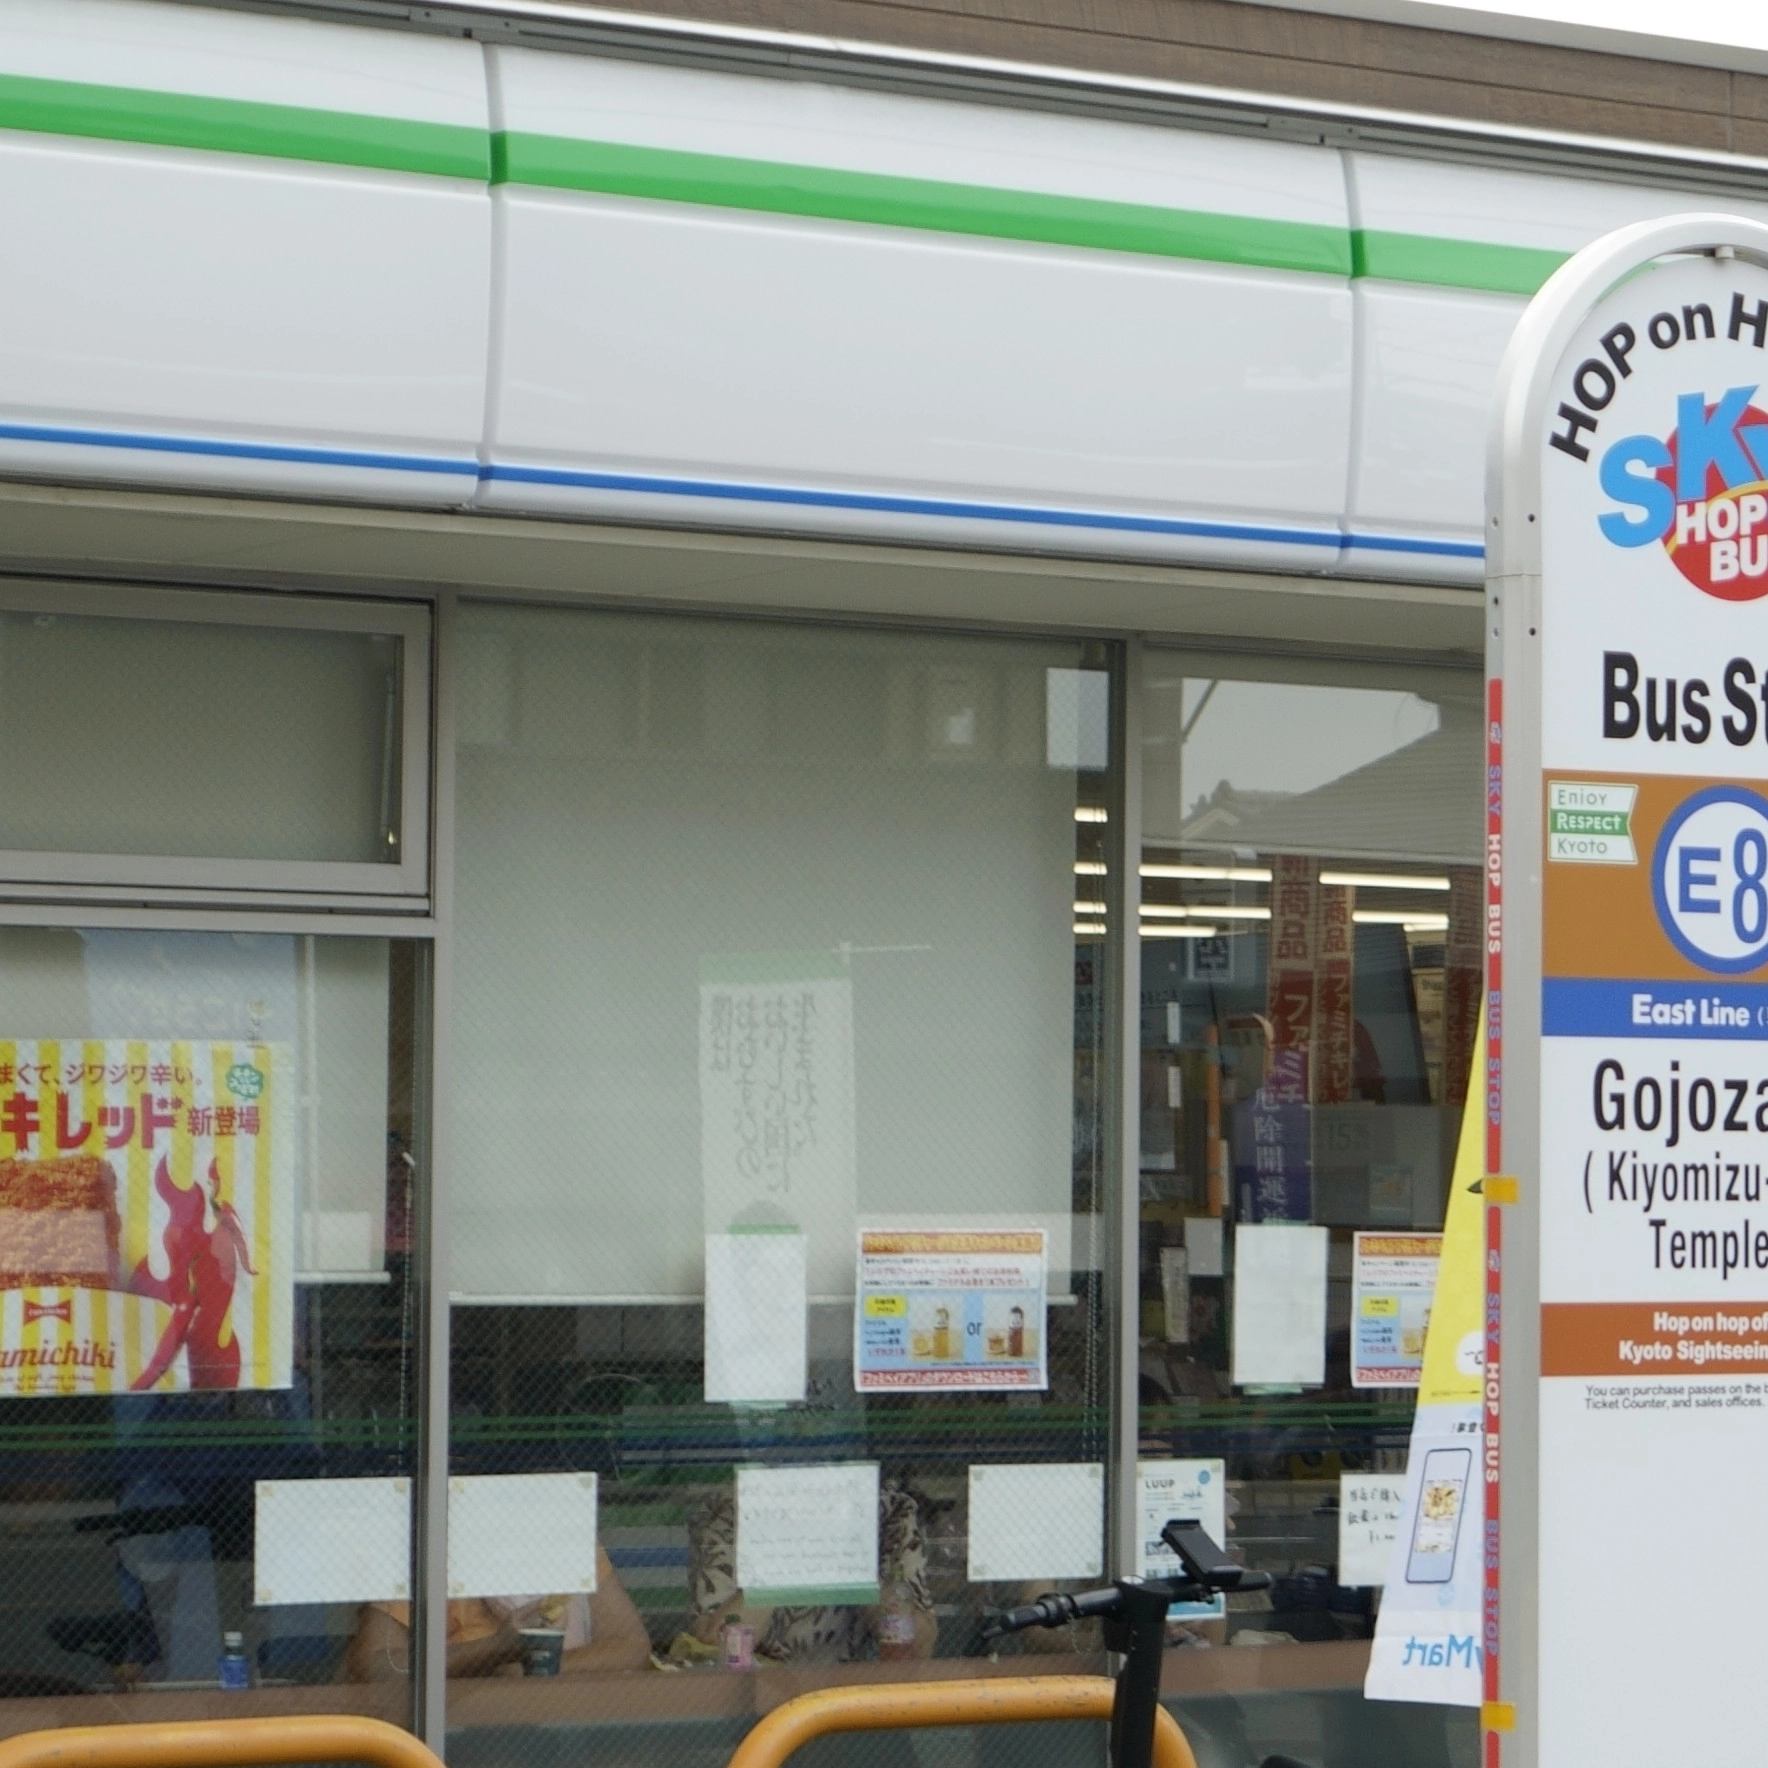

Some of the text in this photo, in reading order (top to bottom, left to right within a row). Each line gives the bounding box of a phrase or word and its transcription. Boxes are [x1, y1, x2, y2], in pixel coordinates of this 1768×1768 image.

[1549, 321, 1635, 463] HOP
[1648, 303, 1715, 349] on
[1676, 494, 1767, 545] HOP
[1603, 650, 1711, 744] Bus
[1488, 764, 1502, 815] SKY
[1488, 834, 1502, 886] HOP
[1678, 827, 1768, 944] E8
[1488, 905, 1502, 954] BUS
[1633, 994, 1694, 1026] East
[1700, 998, 1750, 1027] Line
[187, 1106, 261, 1138] 新登場
[1653, 1311, 1690, 1336] Hop
[1691, 1316, 1714, 1332] on
[1716, 1312, 1749, 1336] hop
[1619, 1340, 1672, 1365] Kyoto
[1487, 1363, 1500, 1415] HOP
[1585, 1398, 1620, 1410] Ticket
[1672, 1397, 1692, 1408] and
[1695, 1397, 1723, 1408] sales
[1586, 1386, 1607, 1398] You
[1609, 1388, 1630, 1398] can
[1632, 1387, 1684, 1400] purchase
[1687, 1387, 1726, 1399] passes
[1728, 1388, 1743, 1396] on
[1745, 1384, 1761, 1395] the
[1486, 1434, 1500, 1483] BUS
[1145, 1478, 1175, 1489] LUUP
